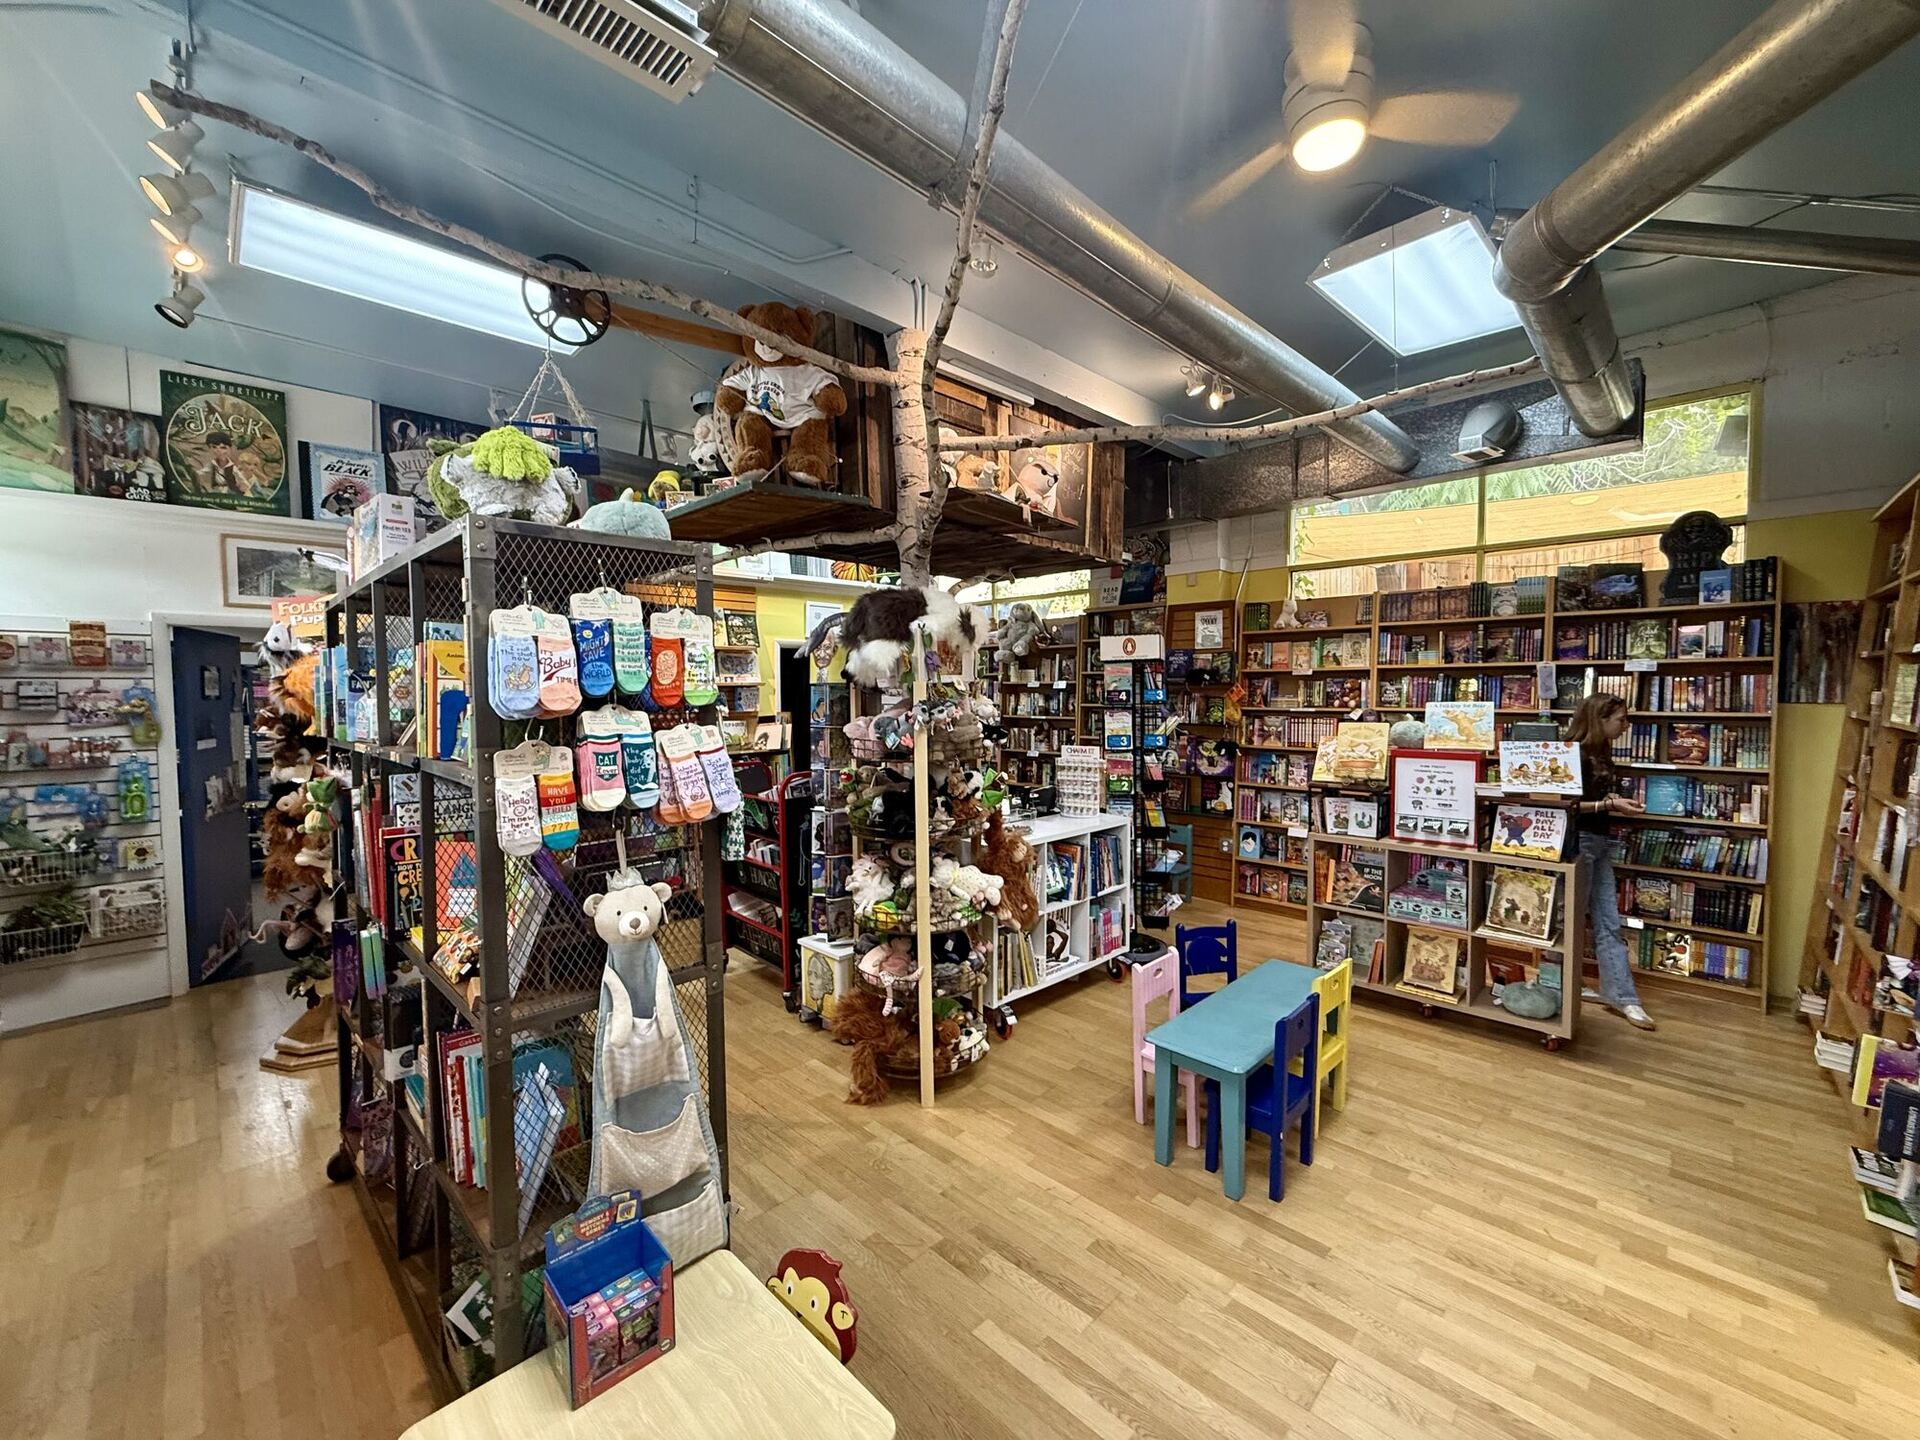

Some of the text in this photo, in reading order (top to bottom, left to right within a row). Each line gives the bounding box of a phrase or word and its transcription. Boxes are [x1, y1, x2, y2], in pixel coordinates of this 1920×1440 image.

[168, 374, 205, 388] LIESL
[184, 405, 264, 438] JACK
[323, 464, 372, 477] BLACK
[129, 486, 150, 496] BAD
[125, 492, 152, 502] GUYS
[580, 636, 604, 652] MIGHT
[583, 646, 606, 664] SAVE
[540, 656, 572, 674] Baby
[584, 669, 612, 679] WORLD
[1118, 692, 1126, 700] 4
[1156, 690, 1164, 700] 3
[1120, 736, 1128, 746] 3
[1156, 736, 1164, 746] 3
[598, 754, 615, 766] CAT
[684, 778, 704, 790] giggle
[1120, 782, 1129, 790] 2
[547, 786, 568, 796] HAVE
[508, 798, 530, 808] Hello
[549, 798, 566, 806] YOU
[546, 806, 572, 815] TRIED
[1534, 810, 1557, 818] FALL
[511, 822, 530, 830] here
[552, 822, 570, 832] ???
[398, 863, 414, 872] HOW
